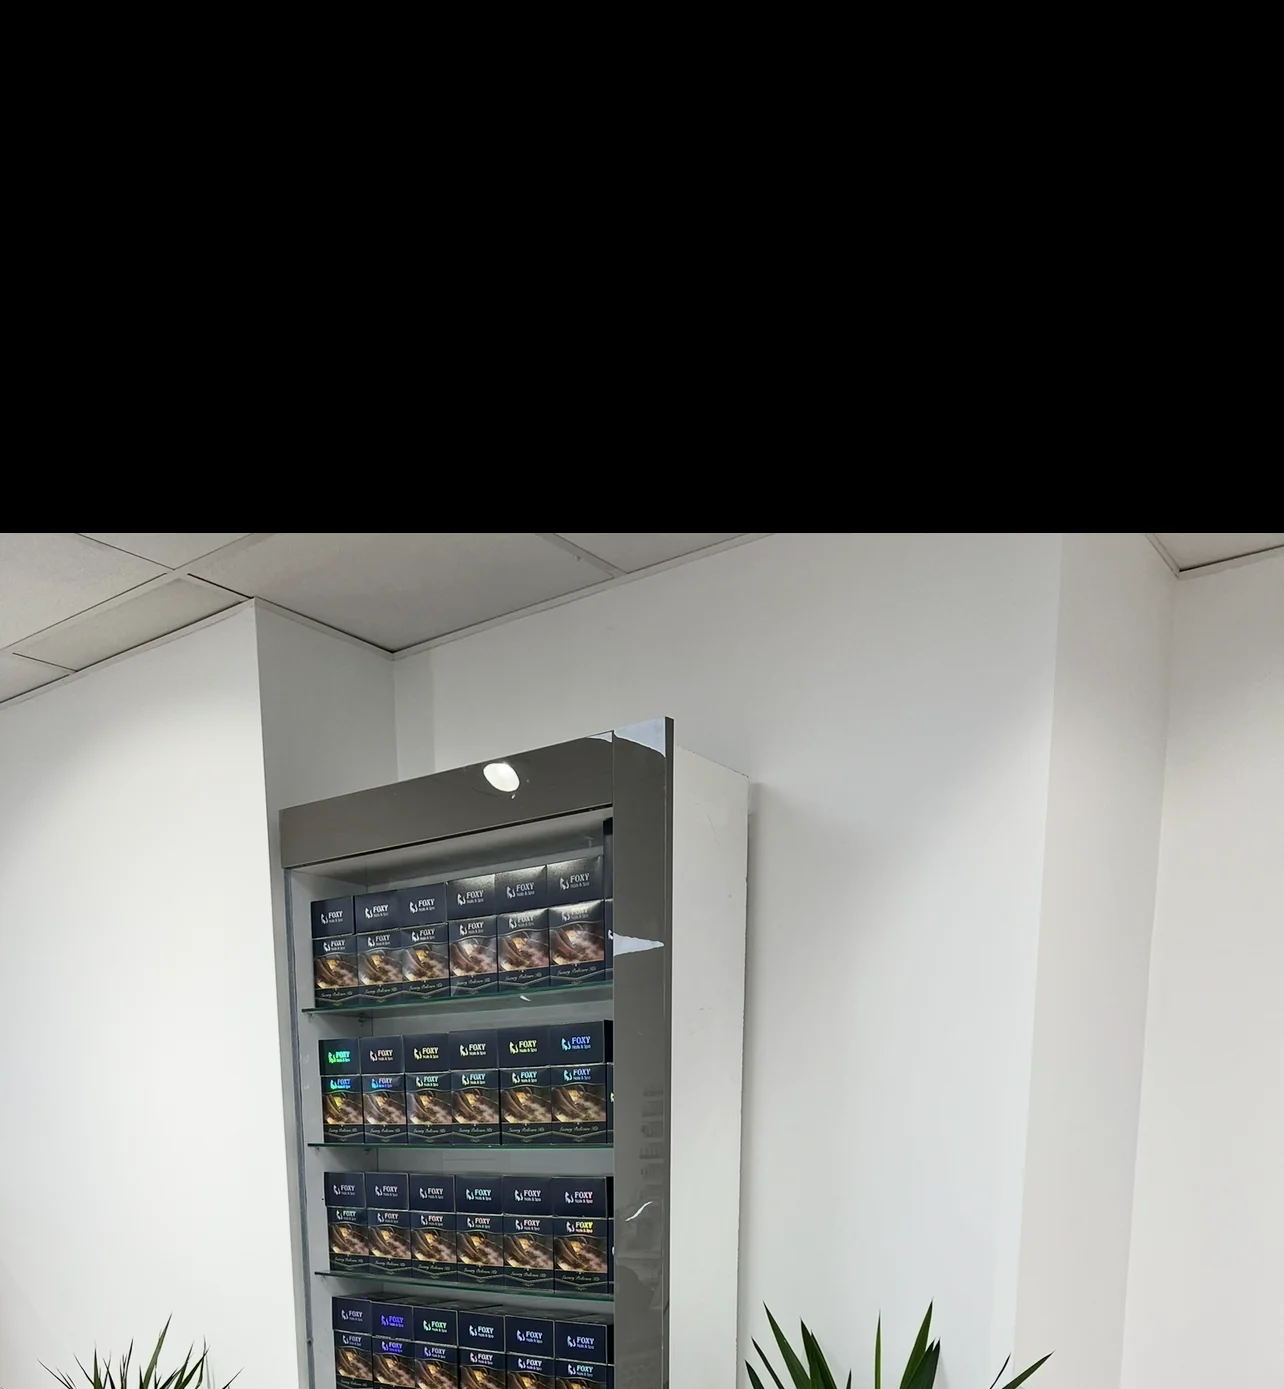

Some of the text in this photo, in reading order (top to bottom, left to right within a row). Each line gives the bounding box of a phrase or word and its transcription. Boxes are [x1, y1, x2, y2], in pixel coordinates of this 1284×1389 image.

[570, 873, 590, 883] FOXY
[516, 882, 535, 892] FOXY
[466, 890, 484, 899] FOXY
[418, 899, 435, 907] FOXY
[373, 905, 388, 913] FOXY
[517, 915, 534, 923] FOXY
[468, 922, 484, 930] FOXY
[519, 1040, 537, 1048] FOXY
[571, 1036, 591, 1044] FOXY
[520, 1071, 537, 1079] FOXY
[478, 1326, 494, 1334] FOXY
[526, 1331, 543, 1339] FOXY
[576, 1337, 594, 1345] FOXY
[478, 1353, 493, 1361] FOXY
